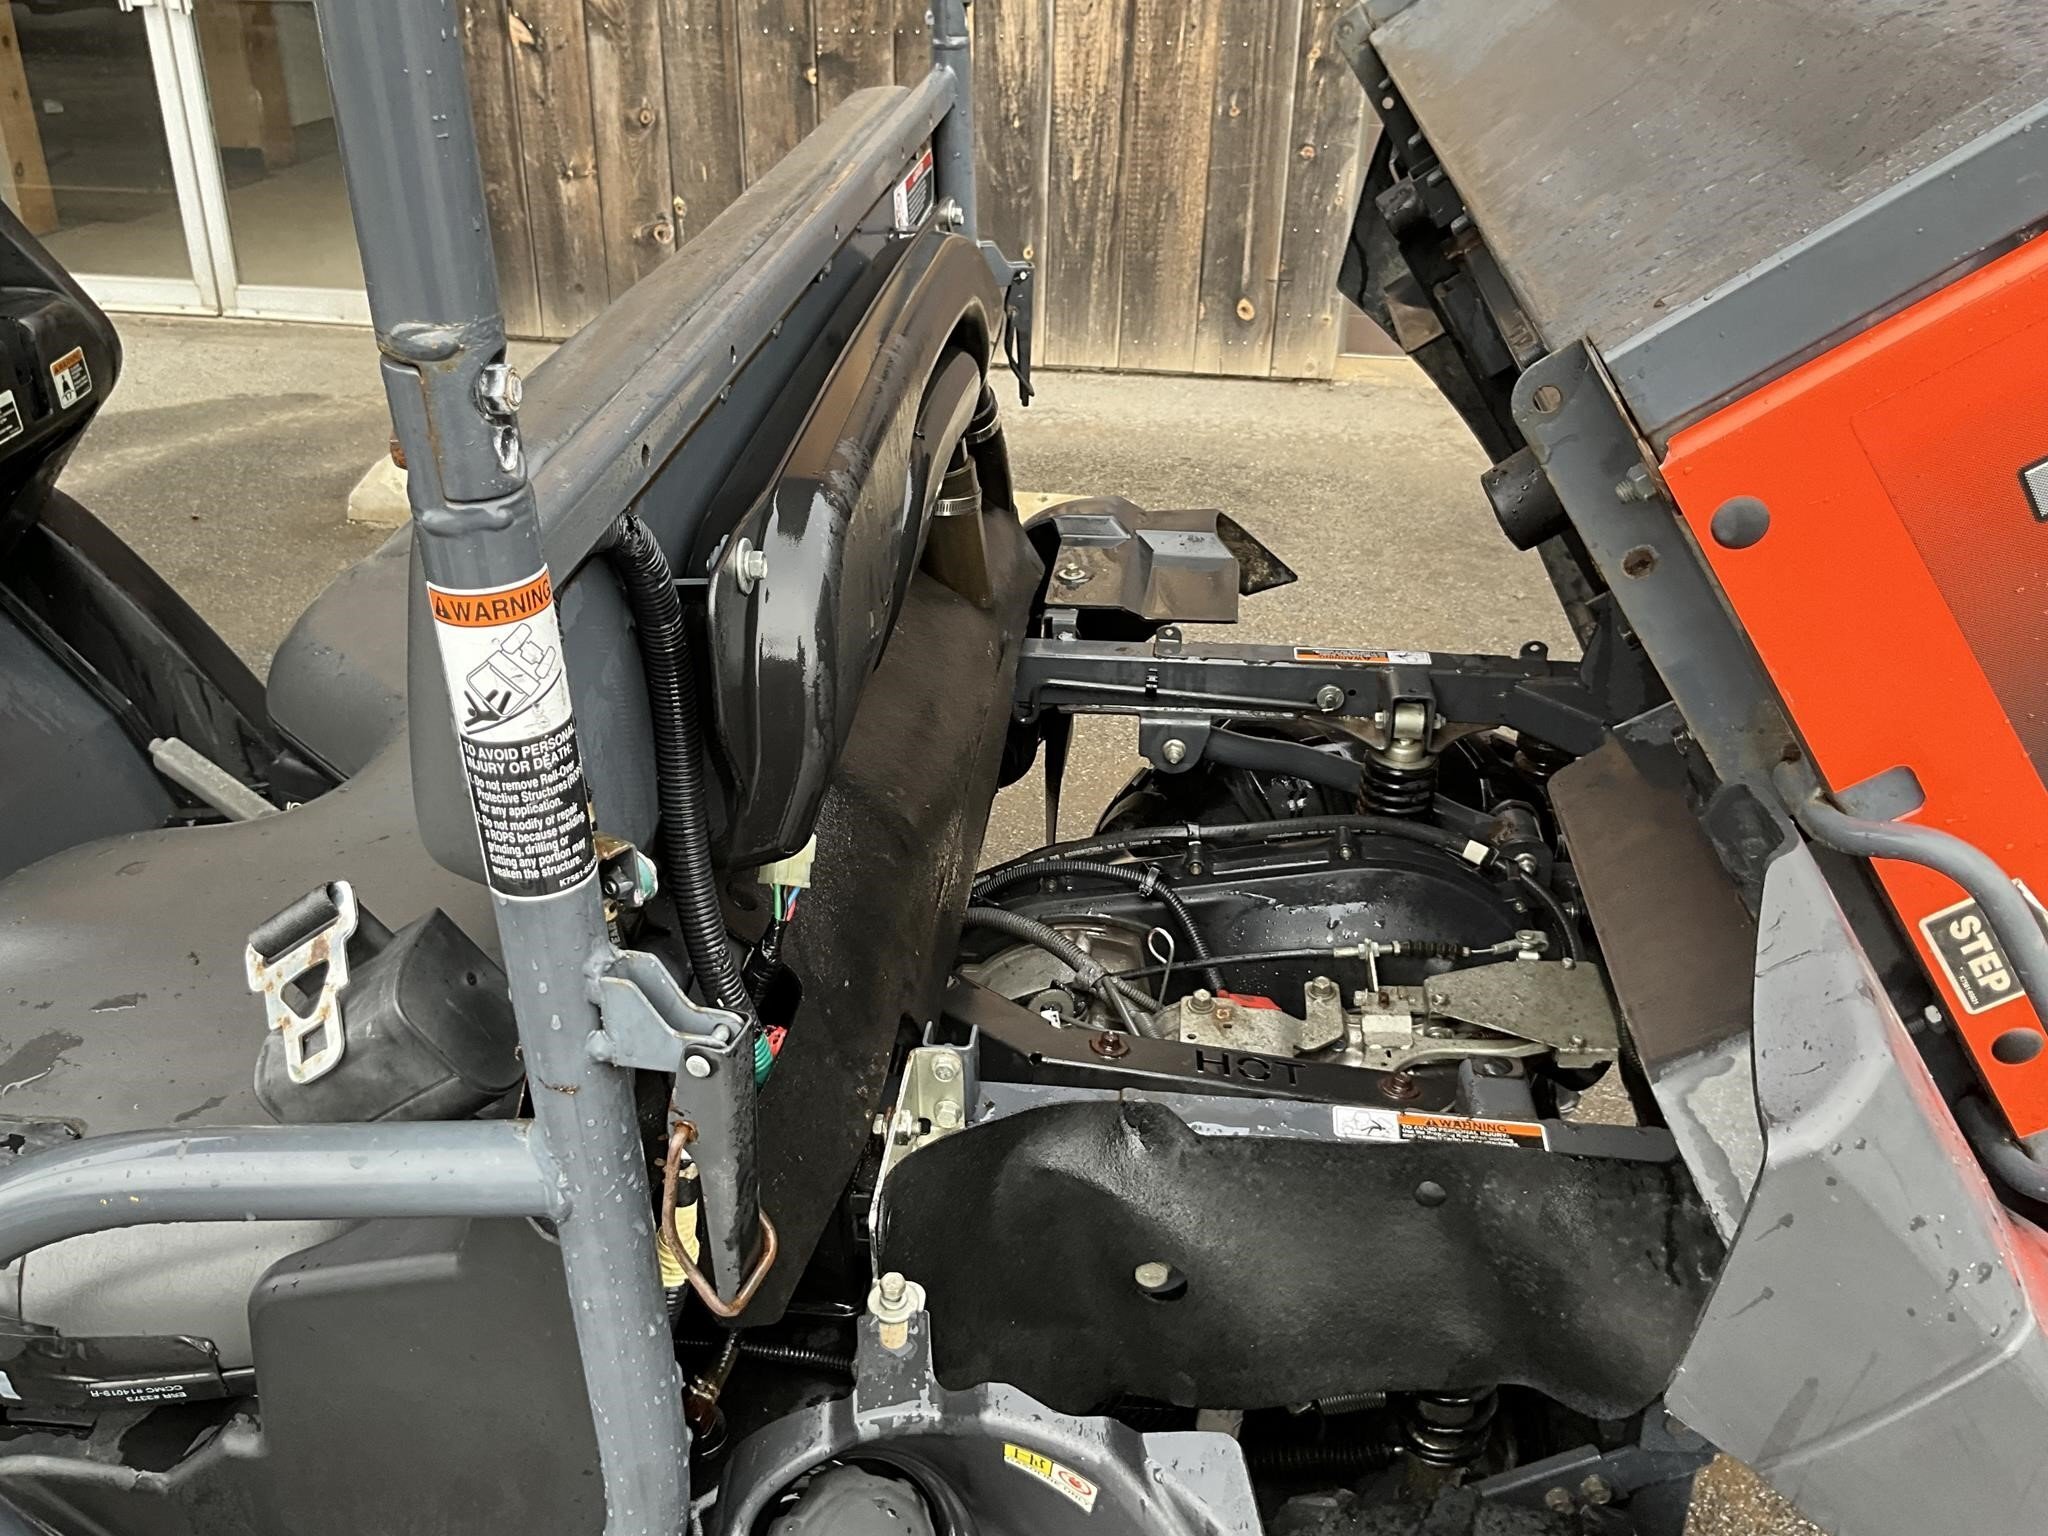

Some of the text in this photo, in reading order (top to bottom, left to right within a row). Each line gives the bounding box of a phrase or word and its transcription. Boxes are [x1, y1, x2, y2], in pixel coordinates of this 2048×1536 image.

[450, 581, 551, 621] WARNING
[463, 723, 576, 760] TO AVOID PERSONAL
[466, 743, 573, 774] INJURY OR DEATH:
[476, 787, 520, 803] Protective
[521, 780, 567, 802] Structures
[485, 780, 501, 791] not
[501, 778, 539, 790] remove
[482, 814, 493, 828] Do
[493, 820, 509, 830] not
[510, 817, 543, 831] modify
[545, 814, 555, 826] or
[556, 802, 578, 821] repair
[490, 805, 507, 818] any
[508, 797, 563, 818] application.
[490, 829, 516, 843] ROPS
[516, 828, 558, 843] because
[558, 811, 586, 834] welding
[488, 835, 569, 858] grinding, drilling or
[490, 836, 586, 870] cutting any portion may
[492, 855, 582, 879] weaken the structure.
[1949, 915, 2011, 991] STEP
[1196, 1049, 1306, 1086] HOT
[1439, 1118, 1508, 1132] WARNING
[145, 1384, 183, 1393] CCMC
